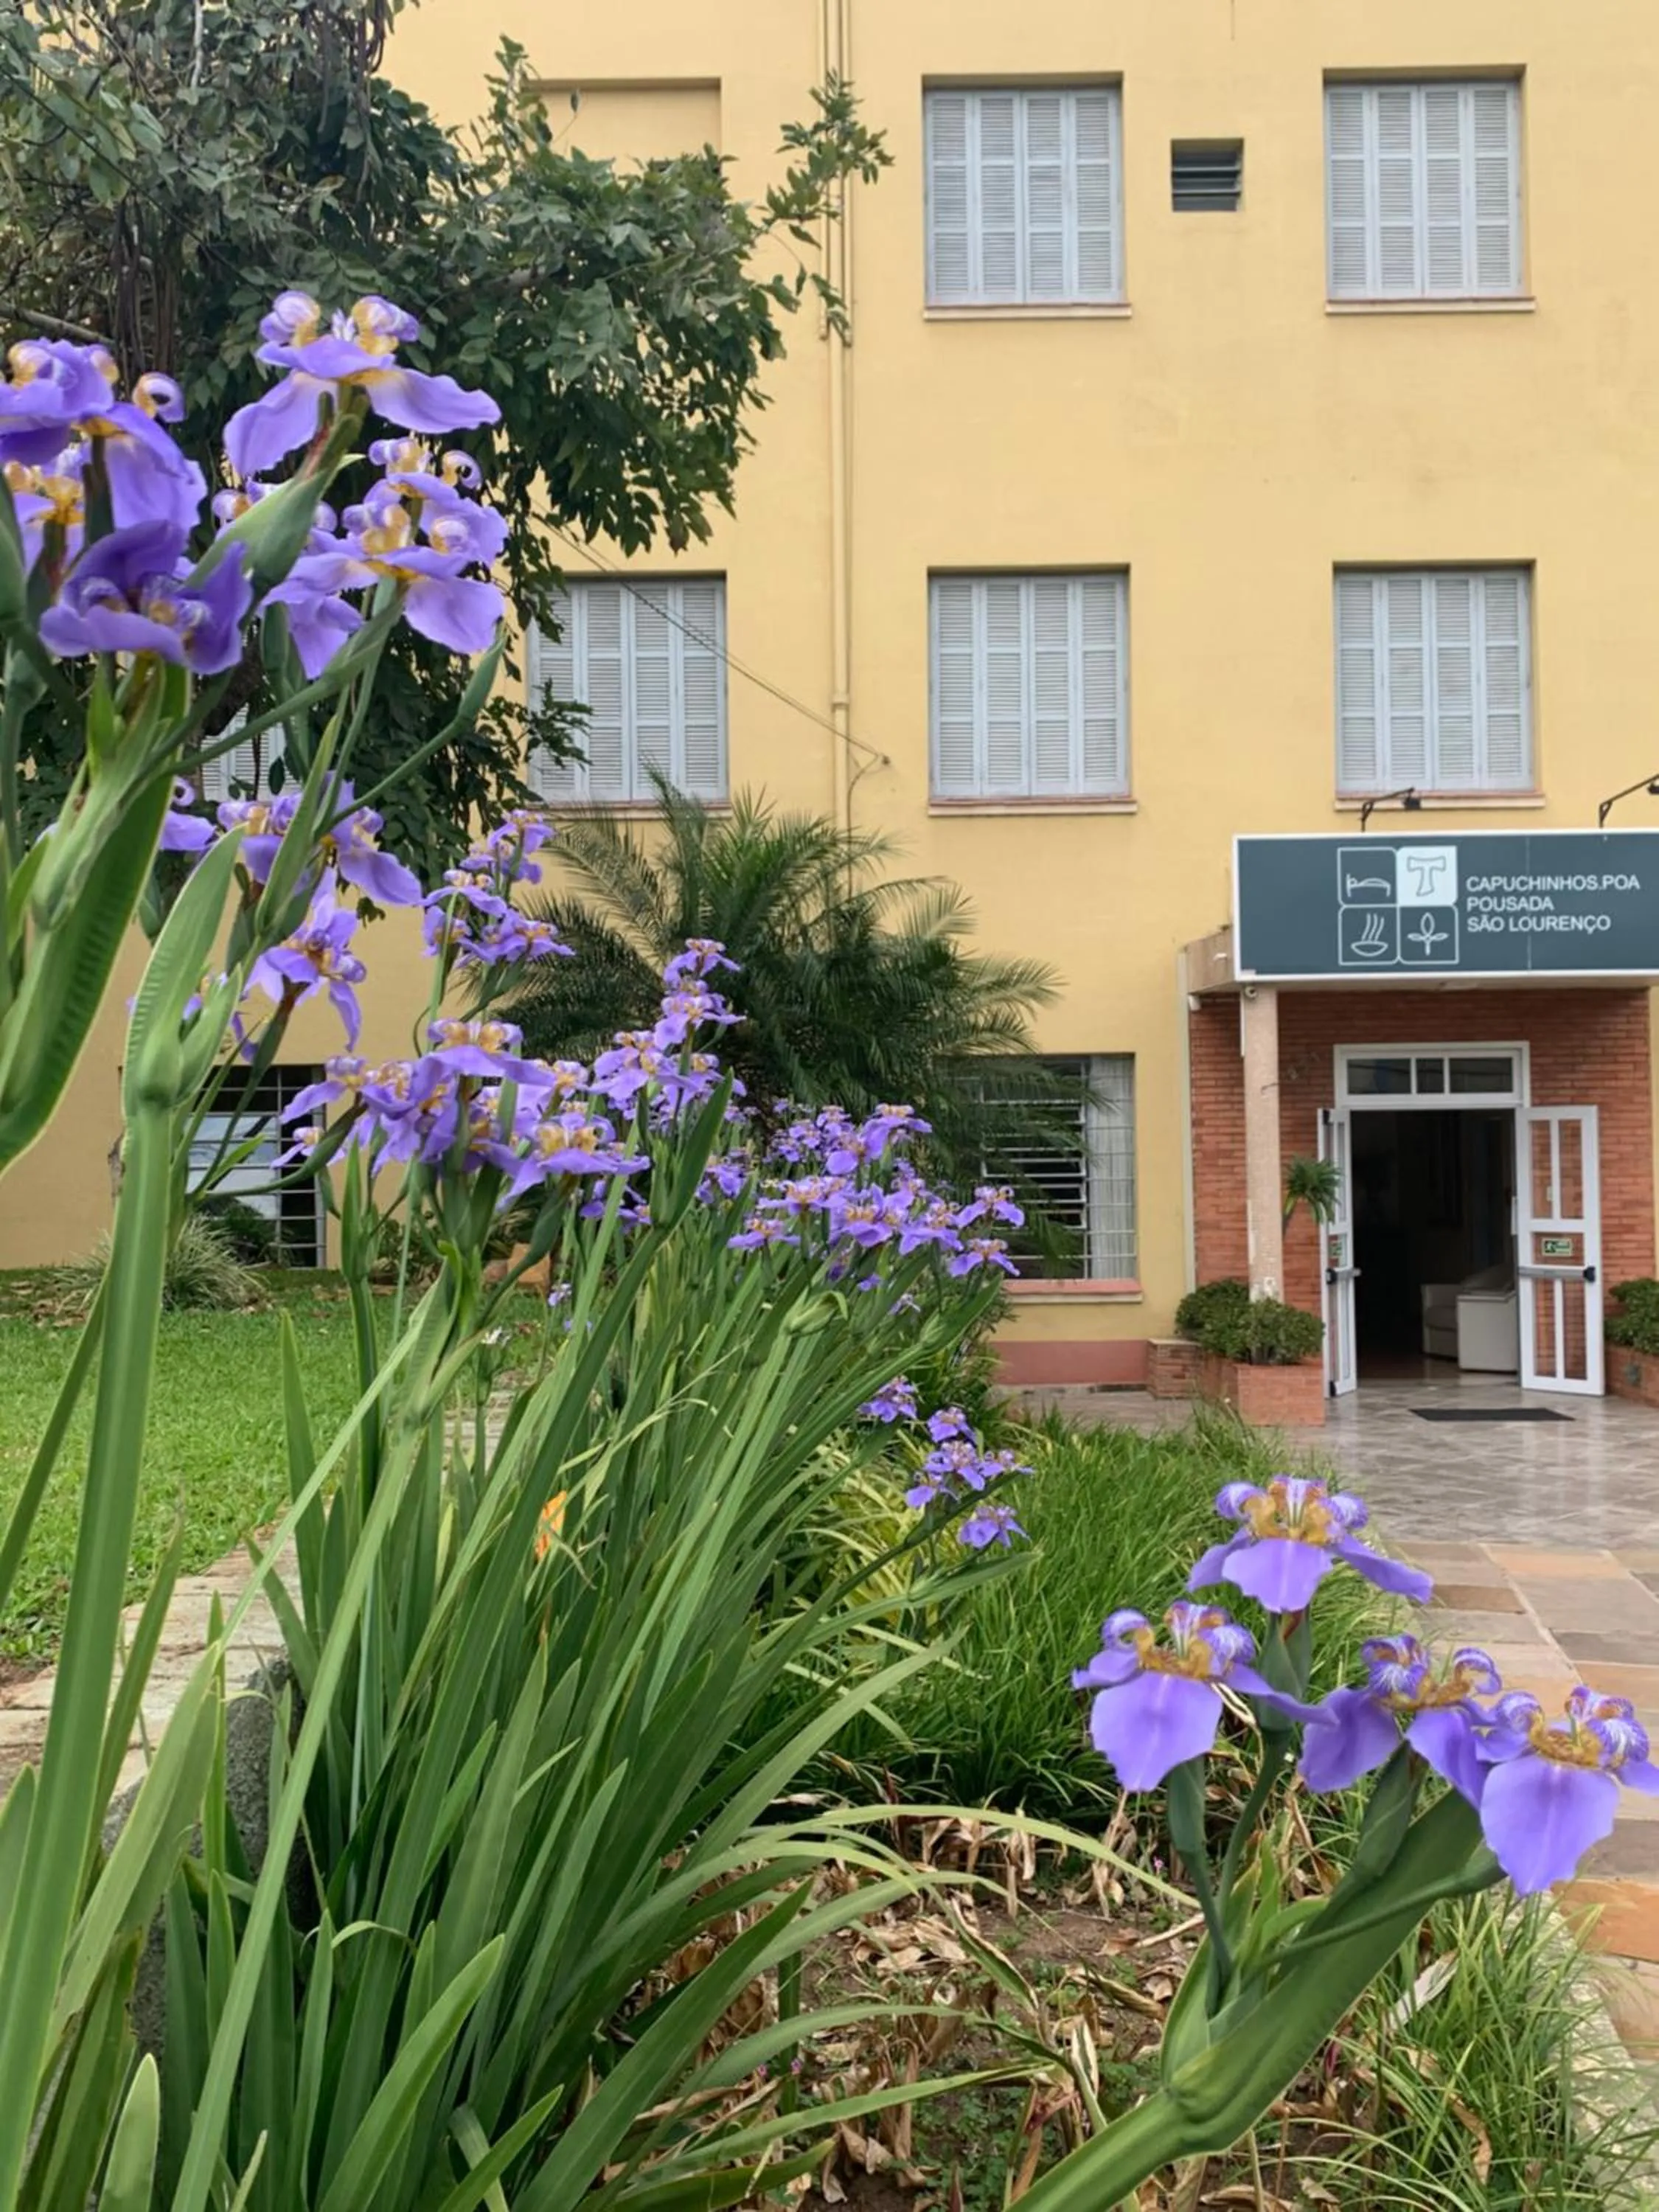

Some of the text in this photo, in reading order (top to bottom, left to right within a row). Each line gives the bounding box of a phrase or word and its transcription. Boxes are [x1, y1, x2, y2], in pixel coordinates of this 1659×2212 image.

[1466, 874, 1641, 892] CAPUCHINHOS.POA
[1467, 897, 1554, 912] POUSADA
[1467, 914, 1611, 934] SÃO LOURENÇO
